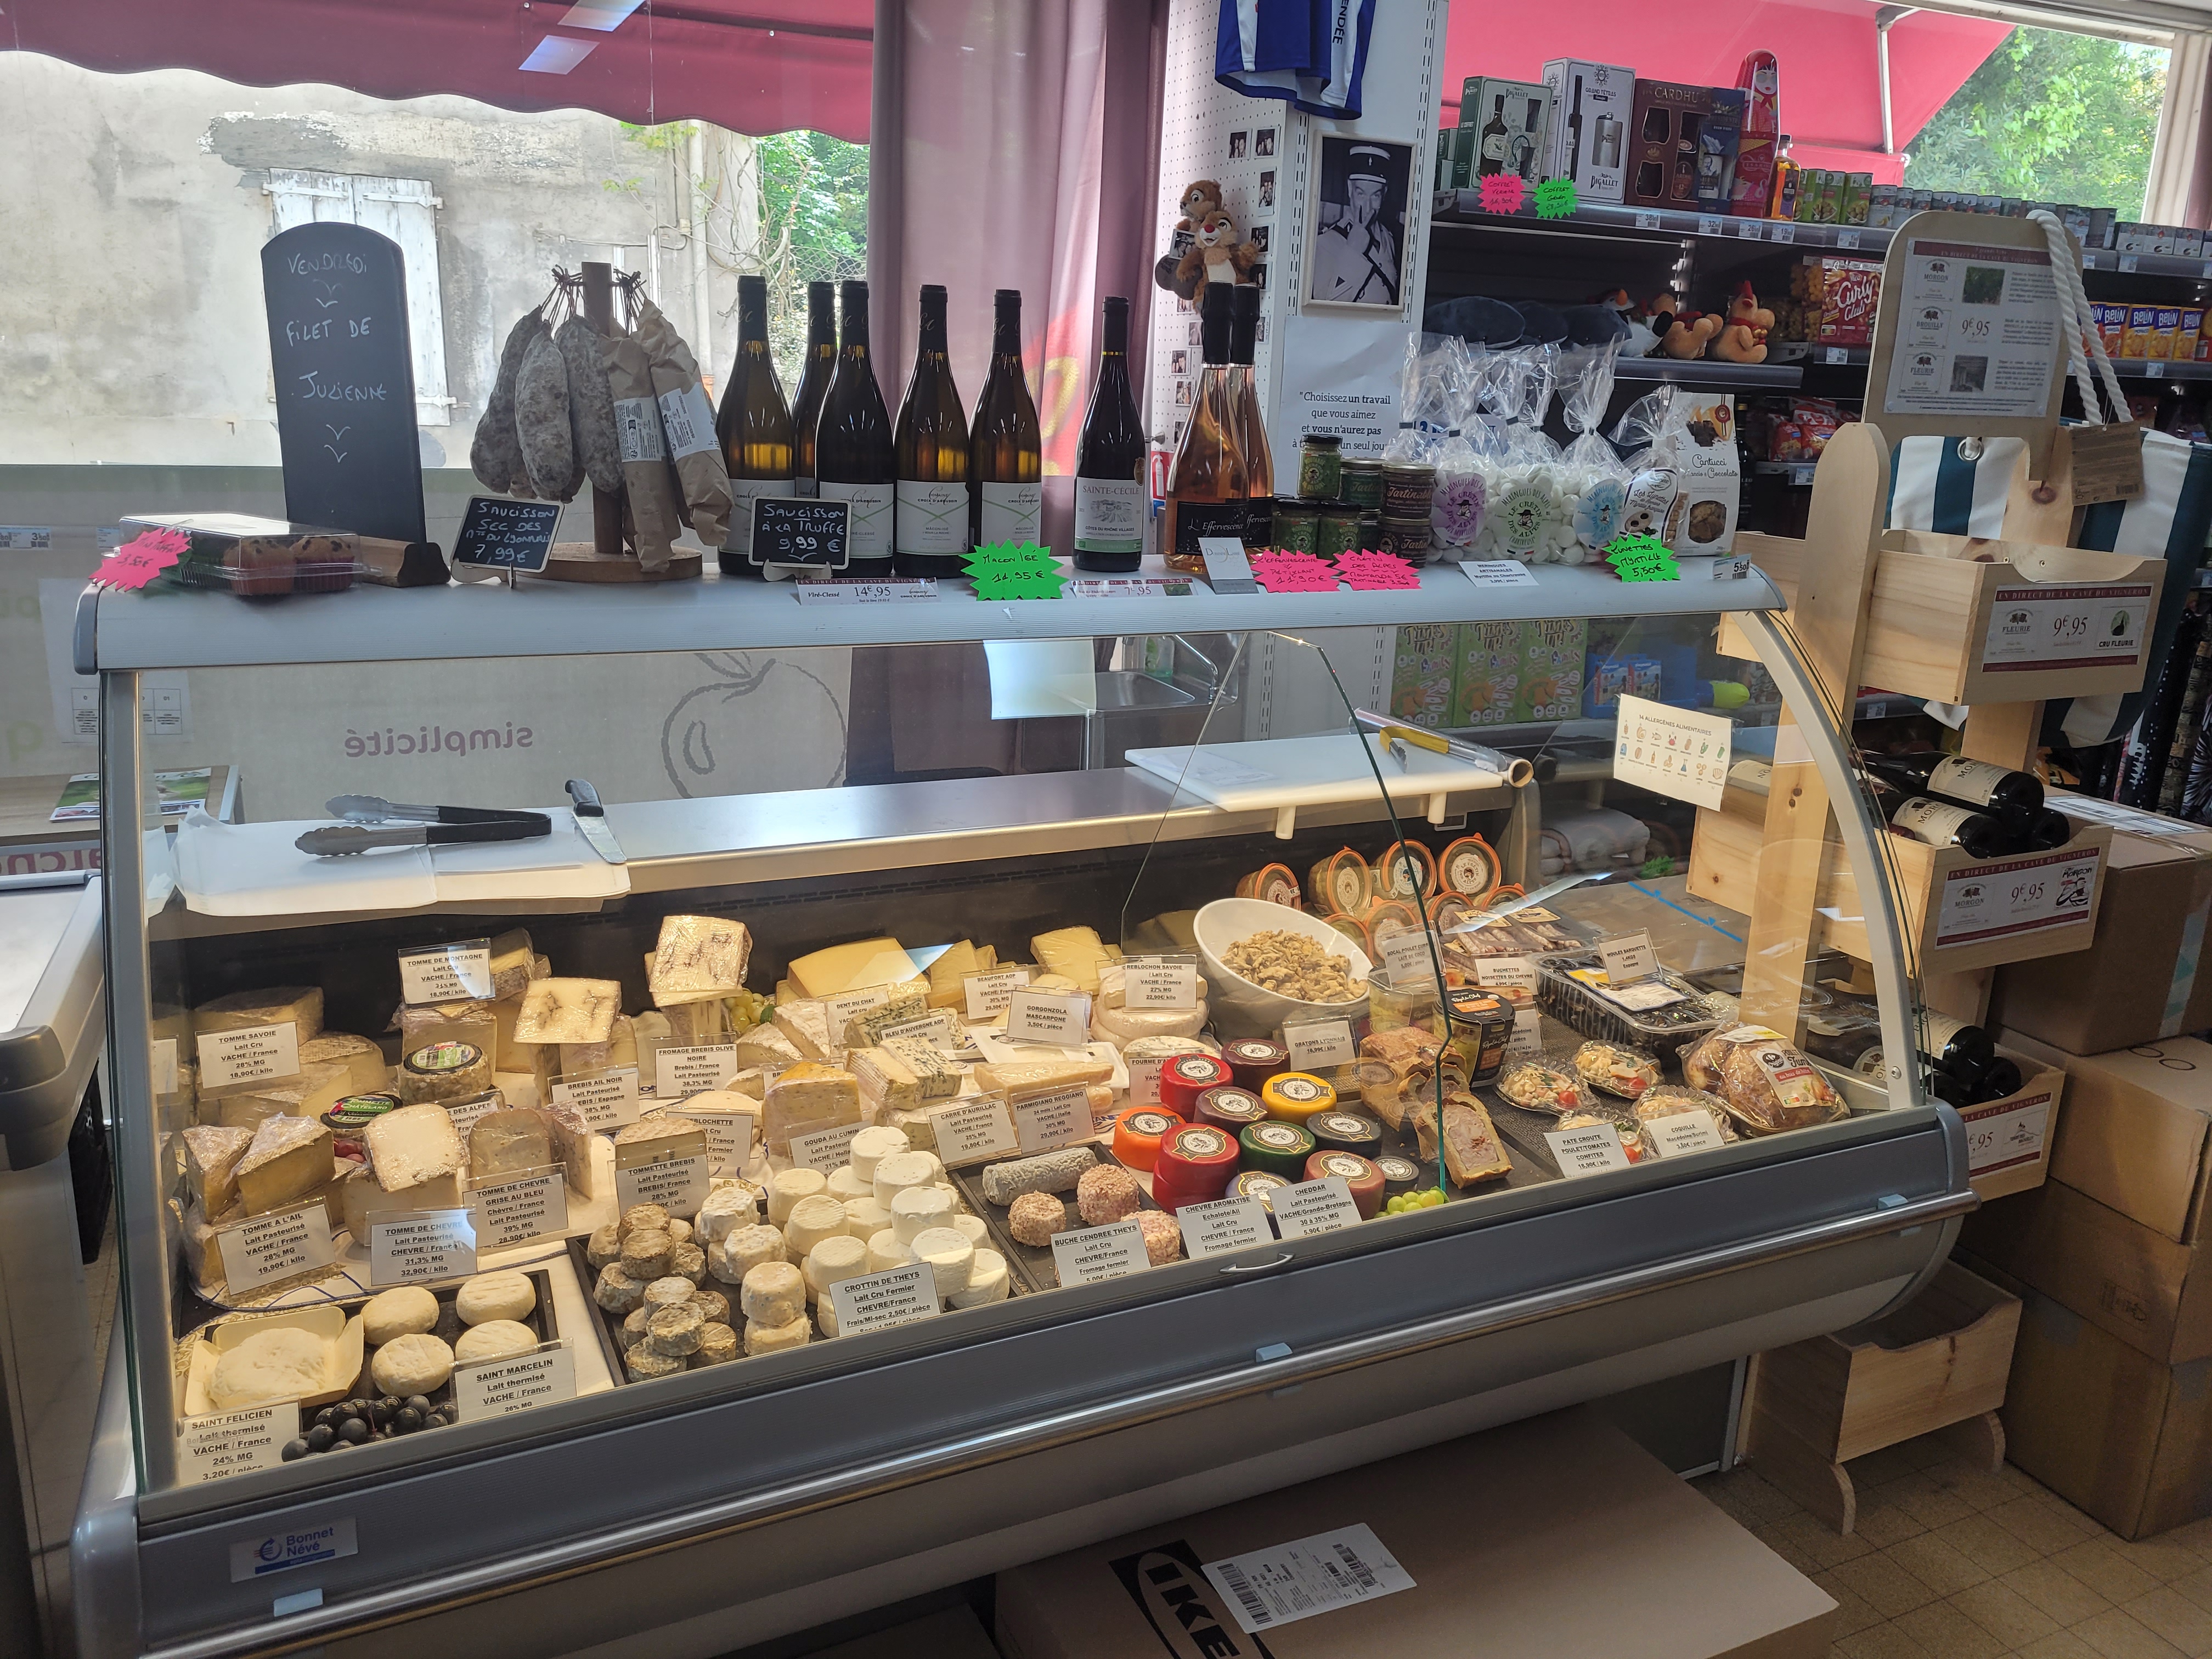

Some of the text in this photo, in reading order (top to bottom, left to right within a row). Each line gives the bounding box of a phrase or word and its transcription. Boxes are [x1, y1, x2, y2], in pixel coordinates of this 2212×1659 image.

[1655, 87, 1699, 103] CARDHU
[1835, 276, 1874, 308] Curly
[1844, 302, 1865, 321] Club
[349, 317, 371, 338] DE
[1348, 395, 1360, 403] un
[1362, 395, 1391, 405] travail
[1311, 409, 1376, 419] que vous aimez
[1301, 425, 1310, 433] et
[1335, 426, 1365, 435] n'aurez
[1367, 427, 1382, 436] pas
[1692, 454, 1727, 468] Cantucci
[1707, 468, 1738, 478] Cioccolato
[1083, 486, 1139, 494] SAINTE-CÉCILE
[1508, 501, 1542, 517] LE CRÉTIN
[478, 519, 541, 531] SEC DES
[799, 520, 844, 535] TRUFFE
[1508, 520, 1541, 537] DES ALPES
[1645, 716, 1675, 727] ALLERGÈNES
[1676, 724, 1712, 736] ALIMENTAIRES
[2063, 866, 2092, 878] MORGON
[1955, 898, 1984, 907] MORGON
[1027, 1006, 1067, 1014] GORGONZOLA
[1026, 1014, 1066, 1022] MASCARPONE
[249, 1030, 276, 1039] SAVOIE
[901, 1021, 933, 1034] D'AUVERGNE
[568, 1080, 592, 1090] BREBIS
[962, 1103, 996, 1114] D'AURILLAC
[1017, 1092, 1084, 1110] PARMIGIANO REGGIANO
[1671, 1124, 1696, 1133] COQUILLE
[804, 1137, 827, 1147] GOUDA
[839, 1128, 859, 1138] CUMIN
[1578, 1135, 1601, 1143] CROUTE
[1576, 1152, 1604, 1160] CONFITES
[628, 1158, 695, 1175] TOMMETTE BREBIS
[477, 1187, 506, 1197] TOMME
[520, 1178, 550, 1188] CHEVRE
[1295, 1184, 1326, 1195] CHEDDAR
[486, 1197, 509, 1206] GRISE
[524, 1189, 544, 1198] BLEU
[1186, 1197, 1251, 1213] CHEVRE AROMATISE
[242, 1222, 273, 1235] TOMME
[283, 1213, 303, 1222] L'AIL
[430, 1221, 462, 1230] CHEVRE
[1054, 1225, 1137, 1246] BUCHE CENDREE THEYS
[844, 1280, 879, 1293] CROTTIN
[893, 1272, 920, 1282] THEYS
[476, 1359, 553, 1381] SAINT MARCELIN
[487, 1373, 545, 1391] Lait thermisé
[192, 1409, 272, 1429] SAINT FELICIEN
[213, 1452, 253, 1465] 24% MG
[286, 1527, 334, 1545] Bonnet
[287, 1541, 320, 1557] Névé
